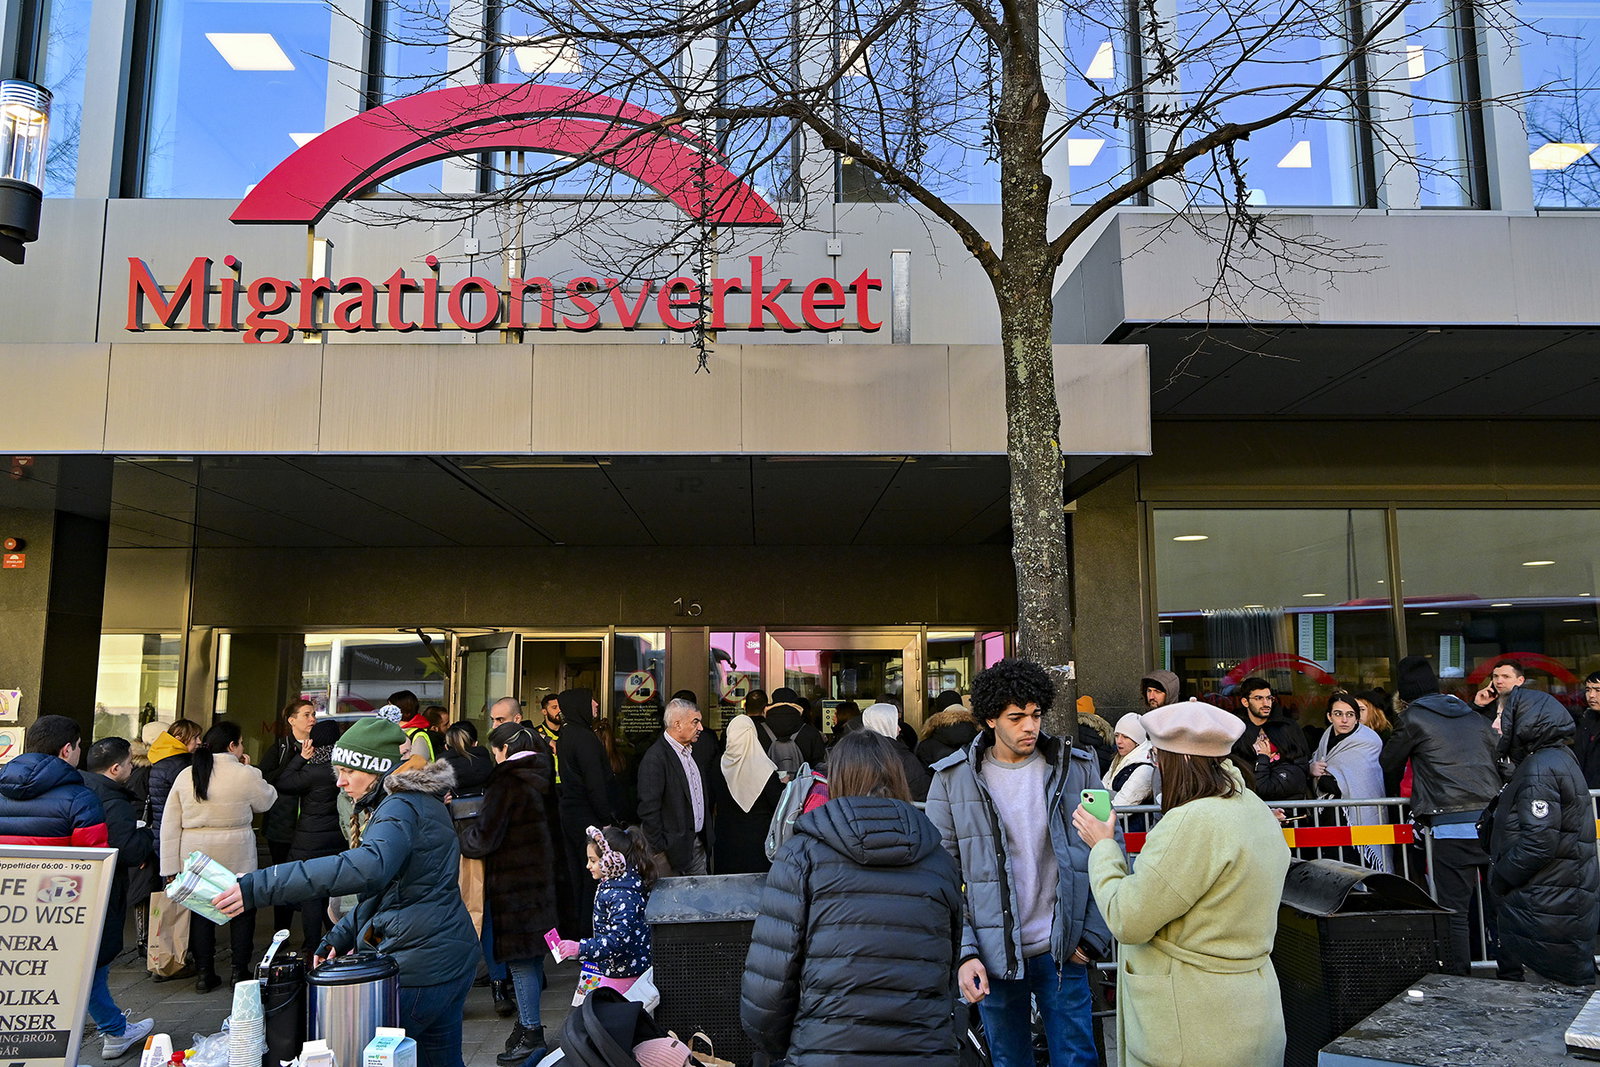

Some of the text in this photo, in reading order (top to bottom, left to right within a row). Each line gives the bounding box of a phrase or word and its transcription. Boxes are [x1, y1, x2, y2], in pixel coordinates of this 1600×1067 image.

[125, 255, 883, 344] Migrationsverket
[0, 878, 27, 896] FE
[36, 906, 87, 924] WISE
[0, 935, 58, 951] NERA
[0, 960, 48, 976] NCH
[0, 1014, 56, 1031] NSER
